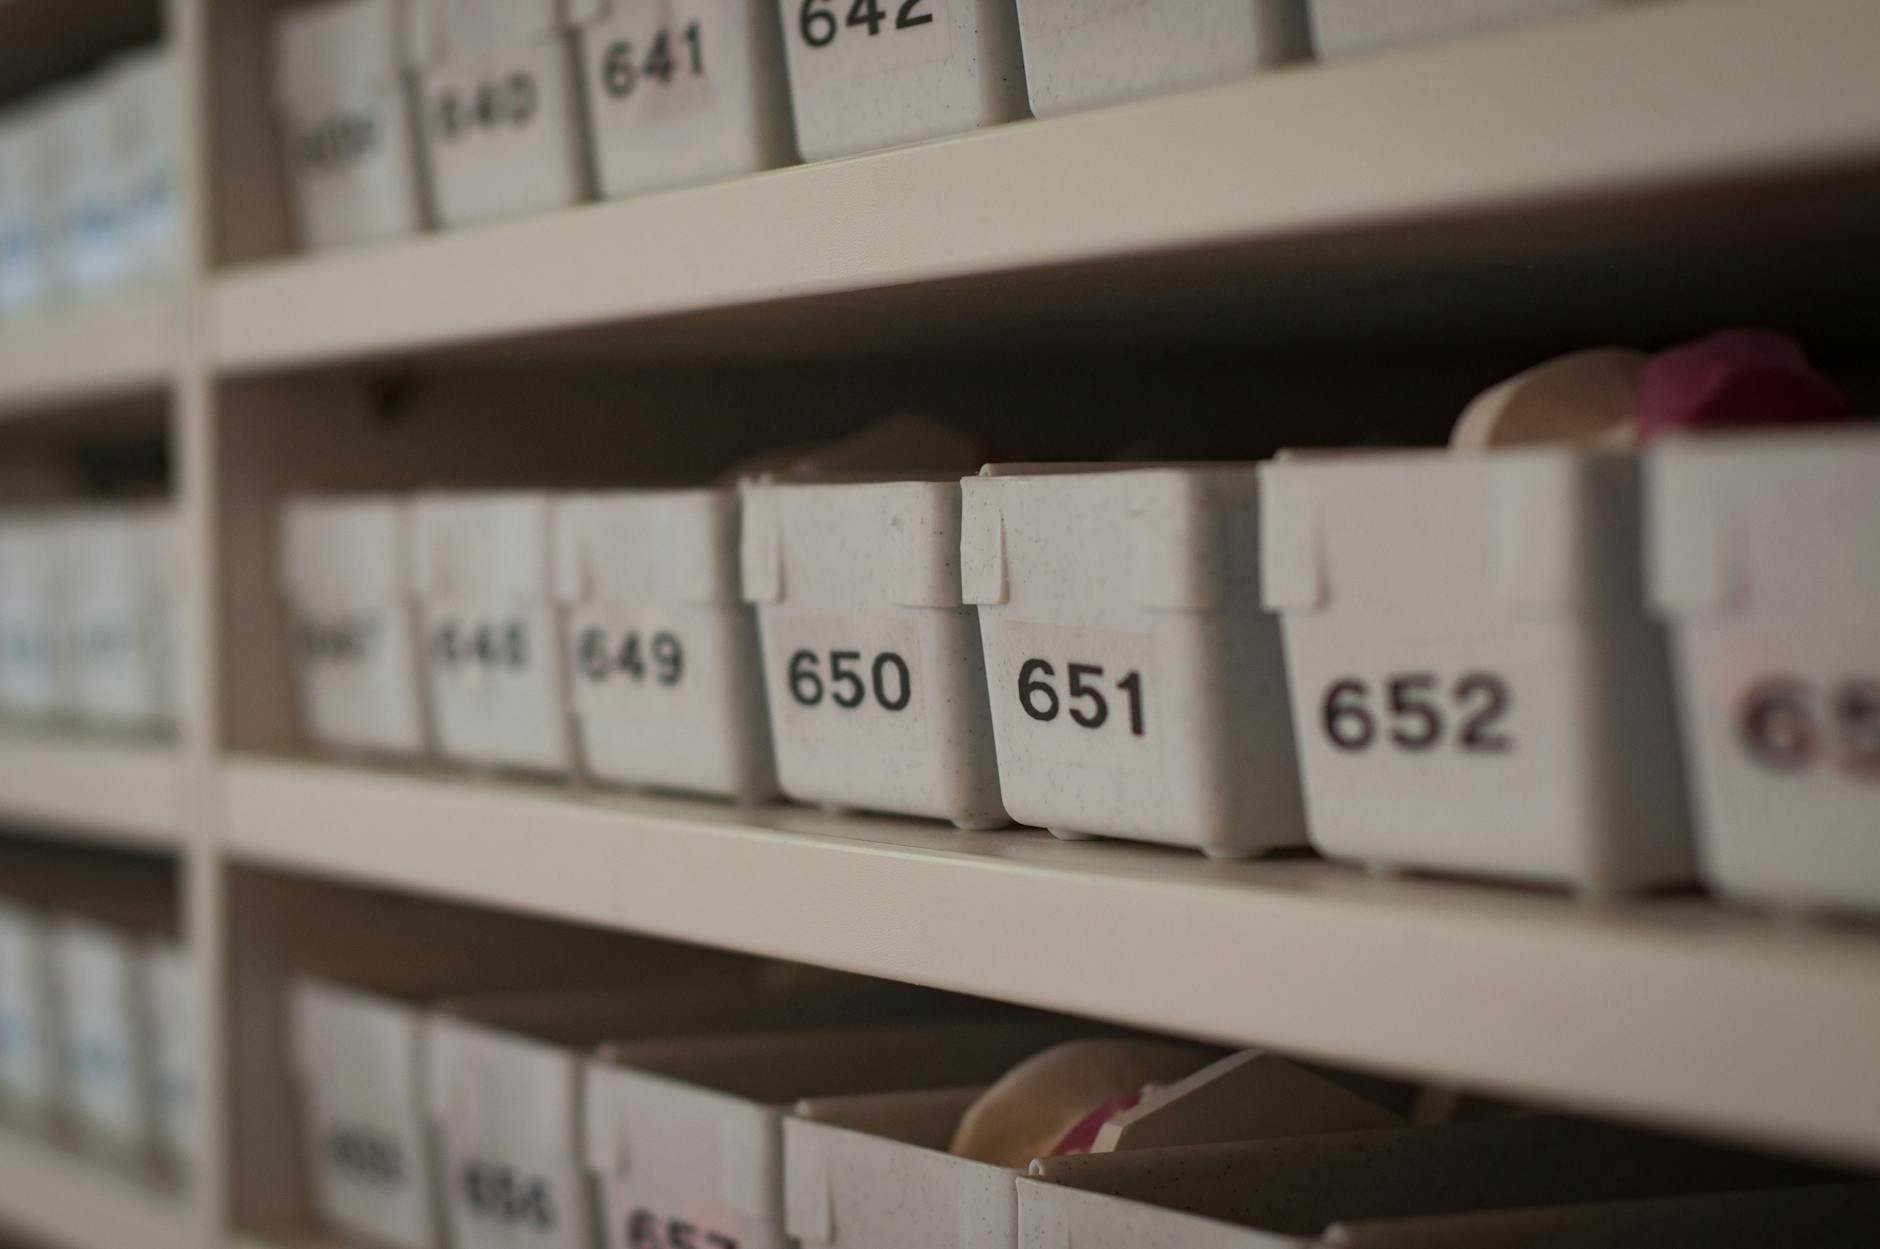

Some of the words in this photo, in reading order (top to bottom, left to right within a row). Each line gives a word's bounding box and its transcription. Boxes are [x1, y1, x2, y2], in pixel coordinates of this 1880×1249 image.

[602, 22, 703, 100] 641
[579, 627, 684, 687] 649
[787, 649, 911, 710] 650
[1018, 658, 1146, 737] 651
[1321, 673, 1512, 757] 652
